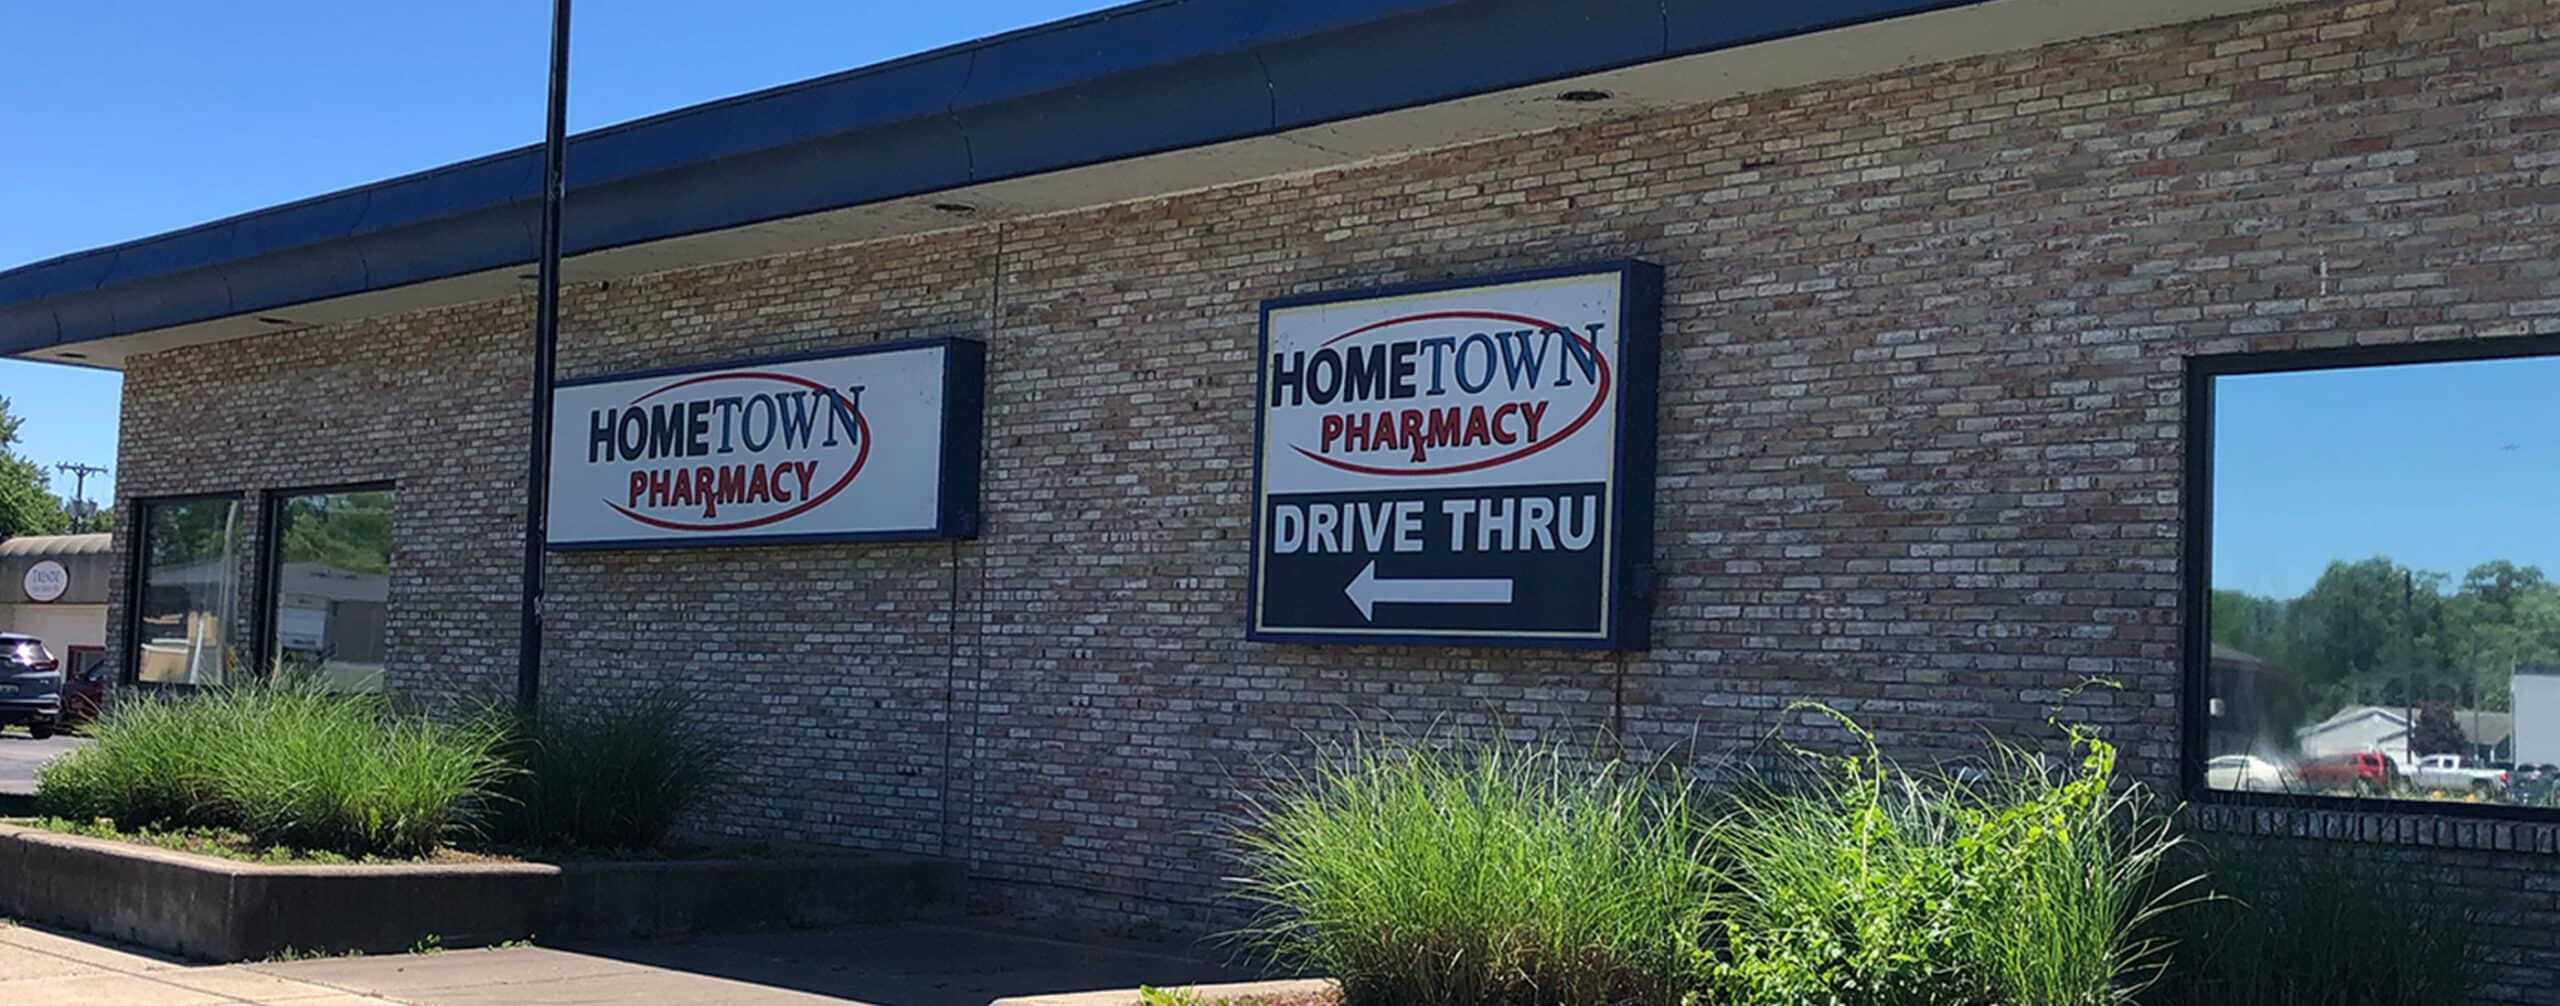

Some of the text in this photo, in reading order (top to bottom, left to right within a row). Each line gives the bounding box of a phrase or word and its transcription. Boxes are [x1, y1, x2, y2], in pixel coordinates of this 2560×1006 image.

[1271, 323, 1604, 407] HOMETOWN
[588, 385, 865, 463] HOMETOWN
[1320, 401, 1549, 462] PHARMACY
[628, 460, 819, 518] PHARMACY
[1273, 495, 1597, 554] DRIVE THRU
